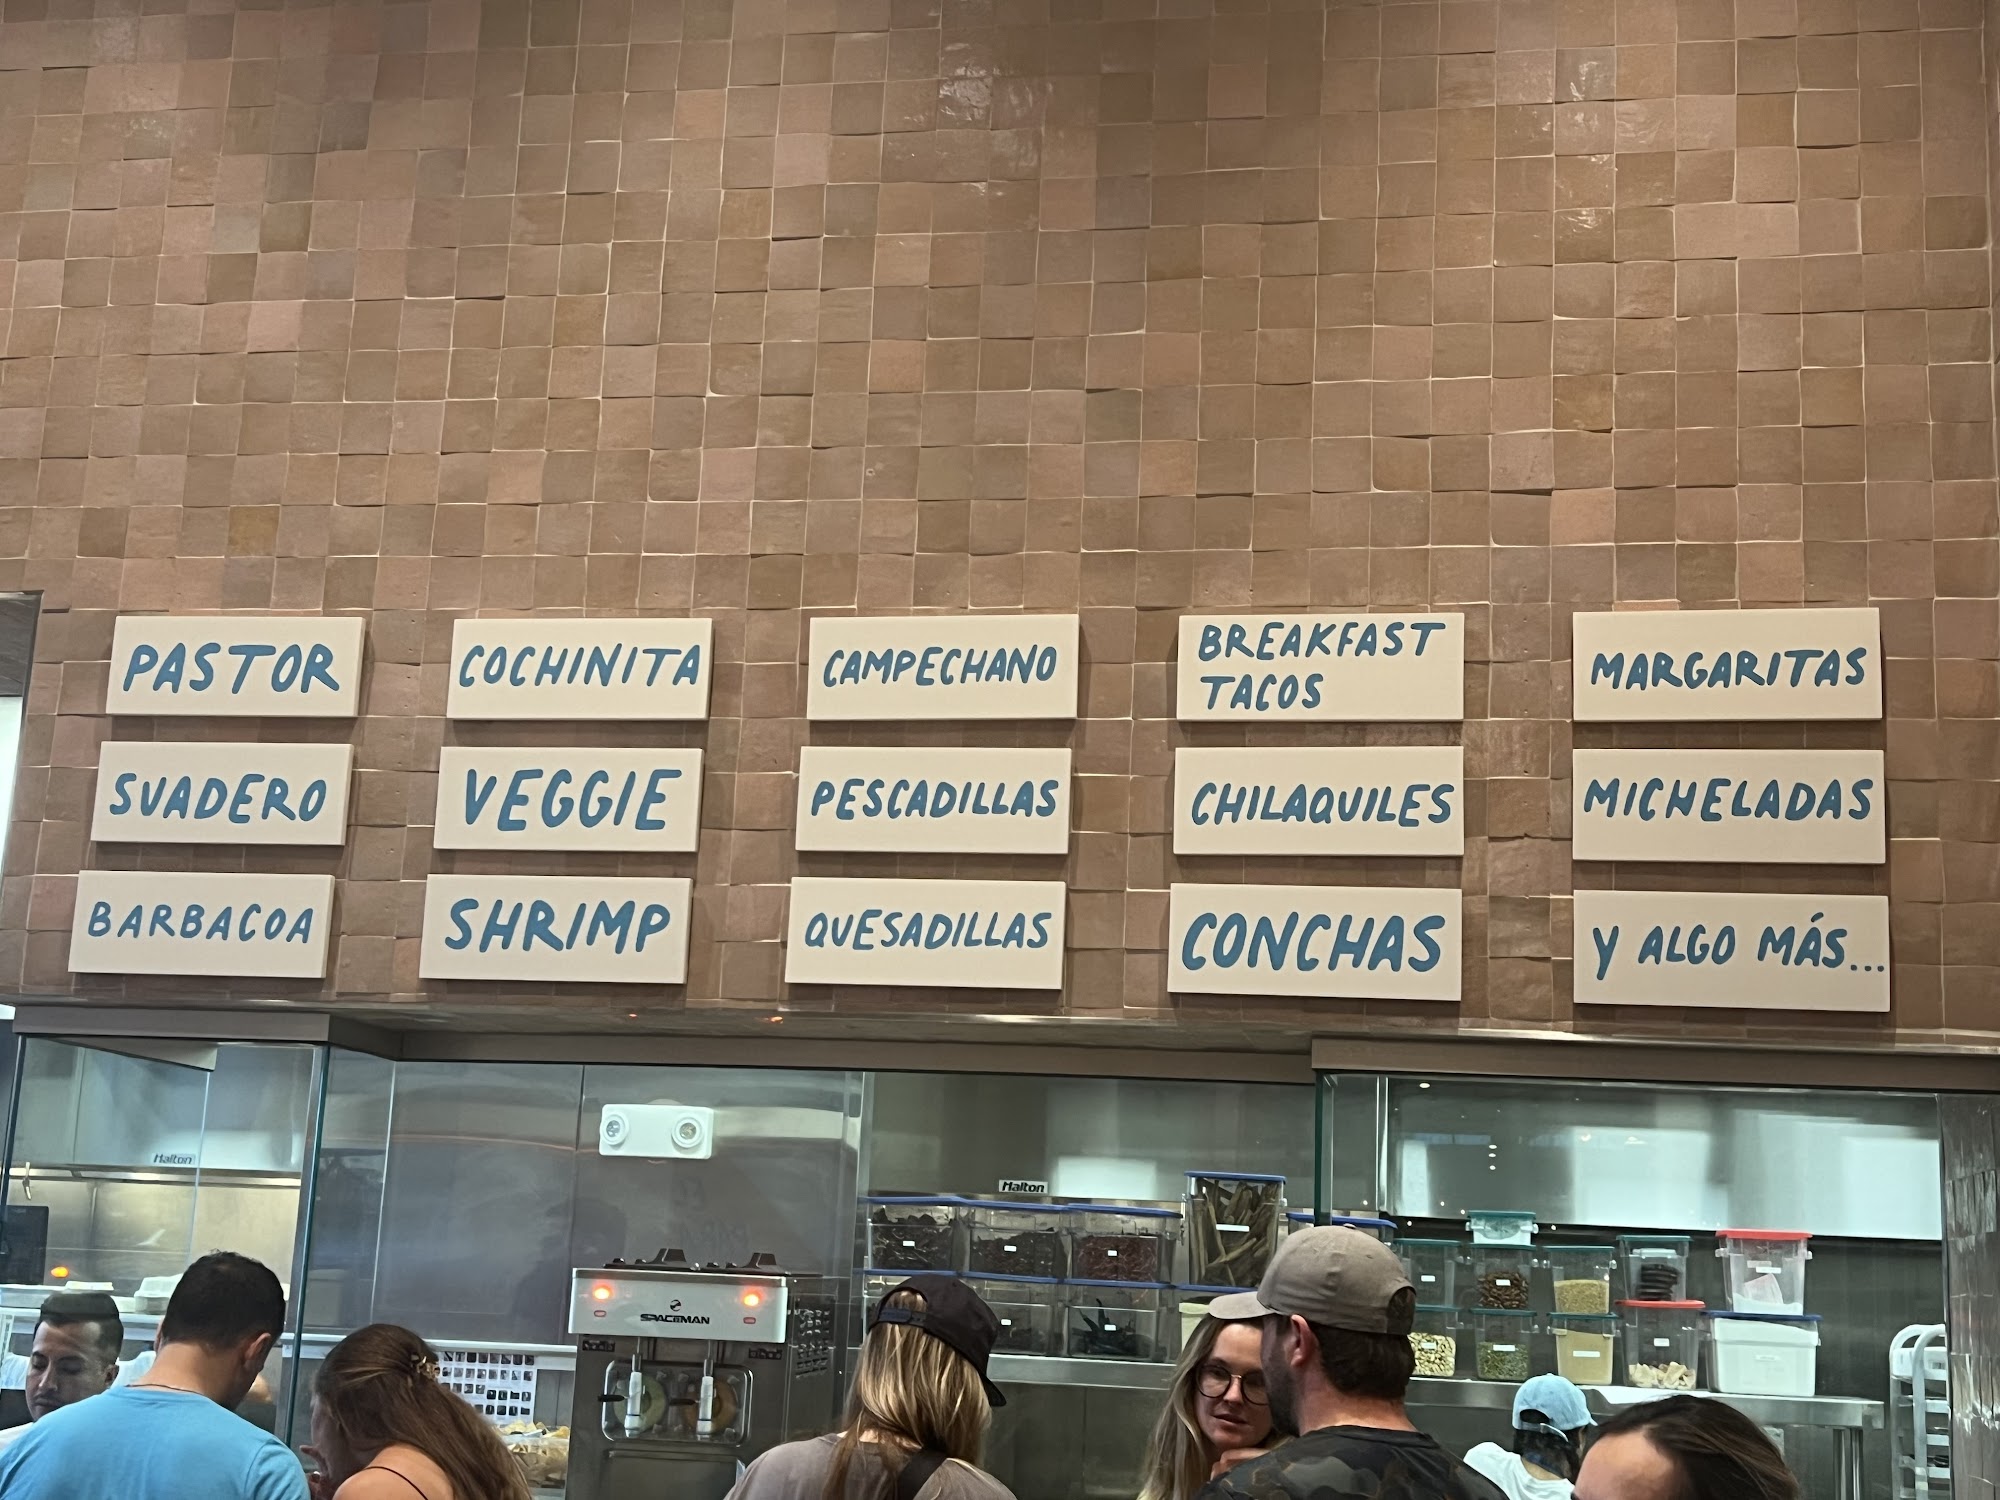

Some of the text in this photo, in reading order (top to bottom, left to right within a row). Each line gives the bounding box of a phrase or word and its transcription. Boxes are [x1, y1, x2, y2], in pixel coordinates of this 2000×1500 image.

[1199, 622, 1446, 661] BREAKFAST
[123, 642, 340, 694] PASTOR
[459, 645, 700, 687] COCHINITA
[824, 645, 1057, 687] CAMPECHANO
[1590, 647, 1867, 690] MARGARITAS
[1201, 673, 1323, 711] TACOS
[109, 772, 327, 825] SUADERO
[465, 768, 683, 832] VEGGIE
[811, 778, 1059, 820] PESCADILLAS
[1191, 783, 1454, 827] CHILAQUILES
[1584, 778, 1873, 822] MICHELADAS
[87, 900, 315, 944] BARBACOA
[444, 897, 671, 955] SHRIMP
[804, 909, 1052, 951] QUESADILLAS
[1181, 911, 1446, 973] CONCHAS
[1638, 925, 1736, 965] ALGO
[153, 1153, 193, 1165] Halton
[1002, 1181, 1045, 1193] Halton
